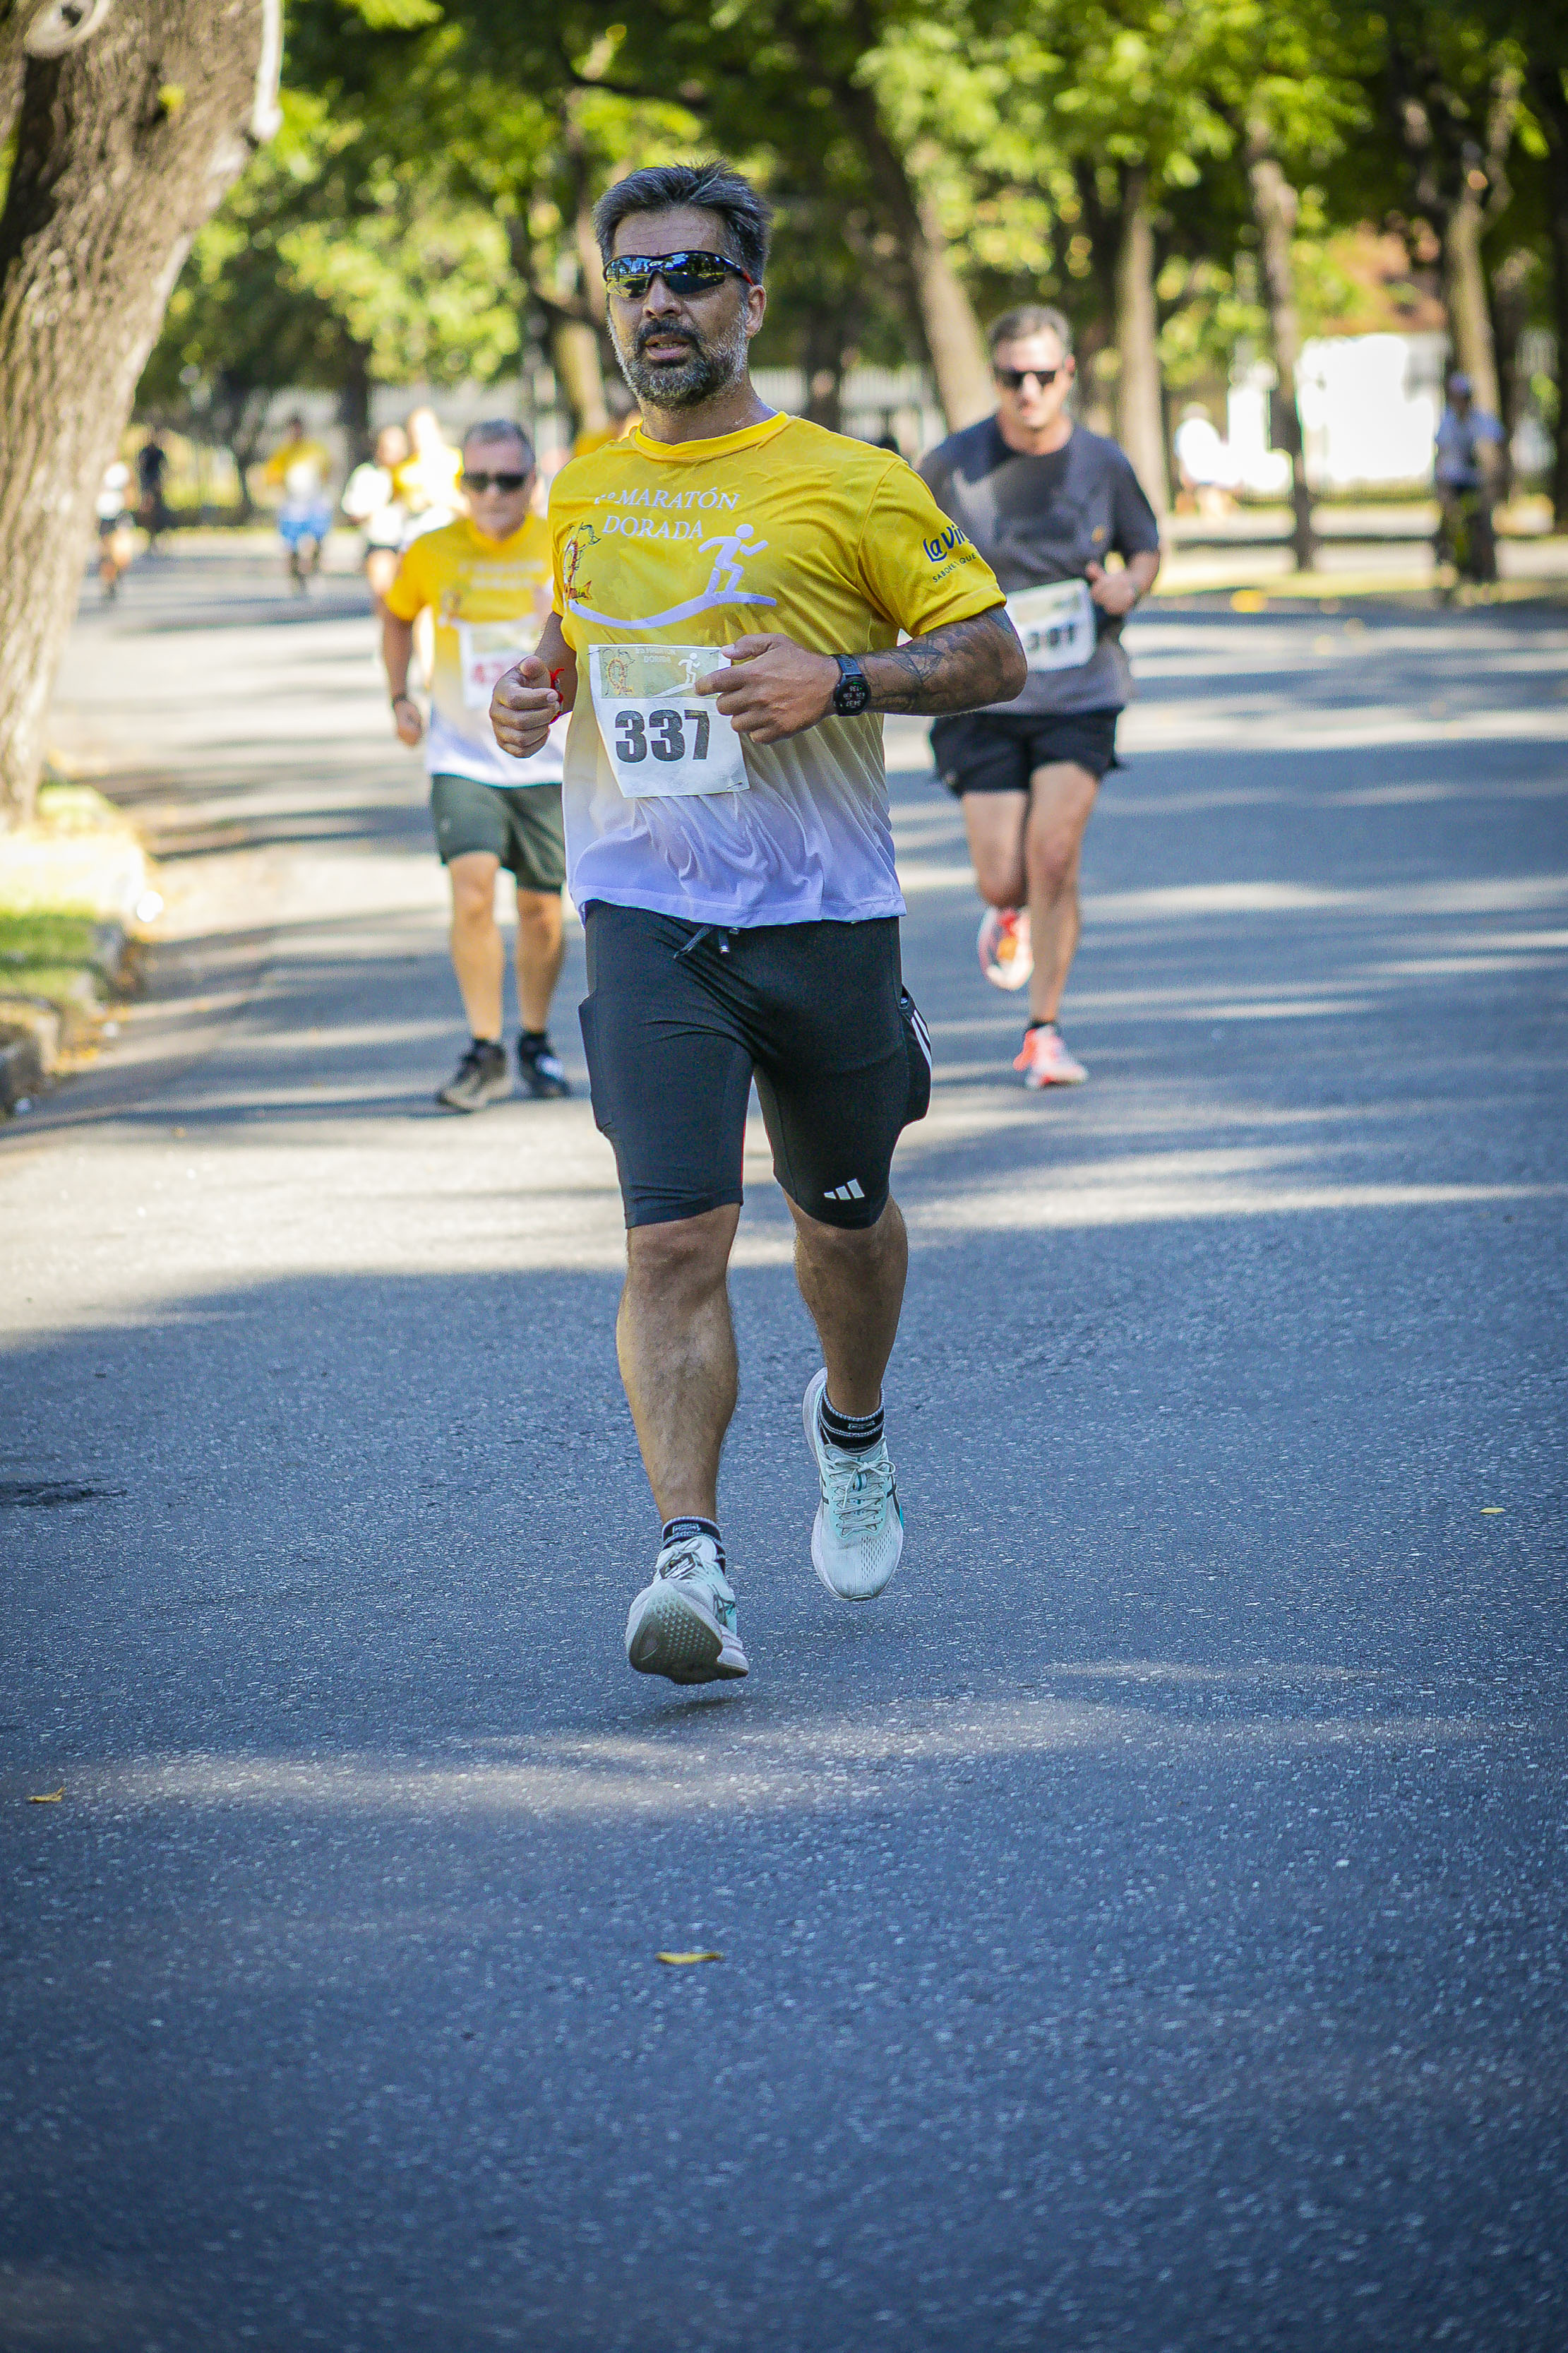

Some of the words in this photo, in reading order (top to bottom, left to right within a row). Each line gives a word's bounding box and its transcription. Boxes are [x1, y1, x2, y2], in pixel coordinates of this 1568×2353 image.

[614, 487, 741, 511] MARATÓN
[602, 515, 703, 540] DORADA
[923, 538, 947, 562] La
[940, 524, 972, 549] Vir
[959, 552, 977, 564] QUE
[615, 709, 710, 763] 337
